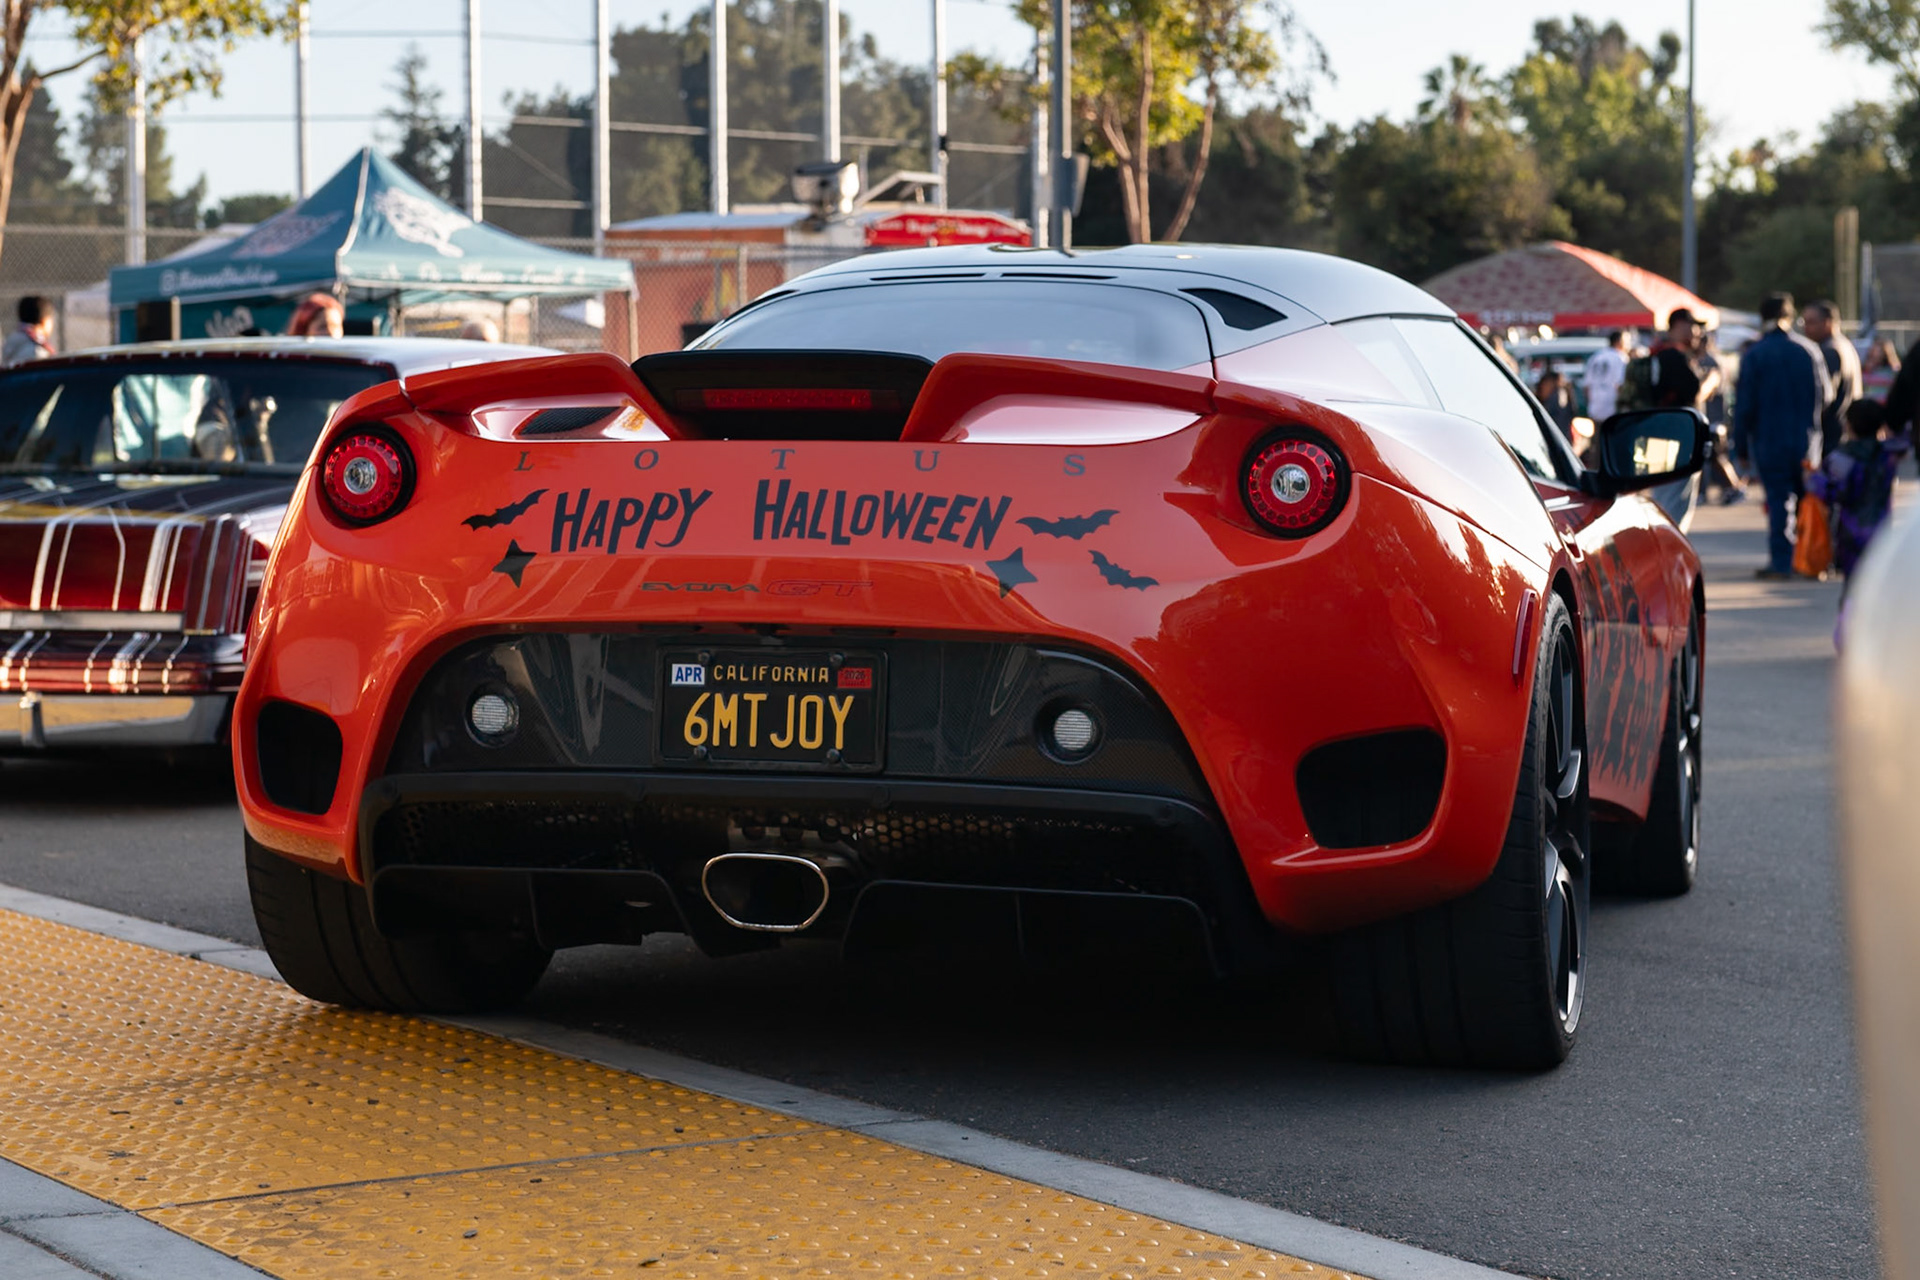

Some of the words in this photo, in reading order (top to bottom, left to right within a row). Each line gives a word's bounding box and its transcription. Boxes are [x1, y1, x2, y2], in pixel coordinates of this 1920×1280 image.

[513, 449, 1086, 476] LOTUS
[551, 488, 713, 554] HAPPY
[753, 479, 1013, 550] HALLOWEEN
[641, 582, 760, 593] EVORA
[766, 580, 874, 596] GT
[675, 666, 702, 682] APR
[713, 664, 829, 683] CALIFORNIA
